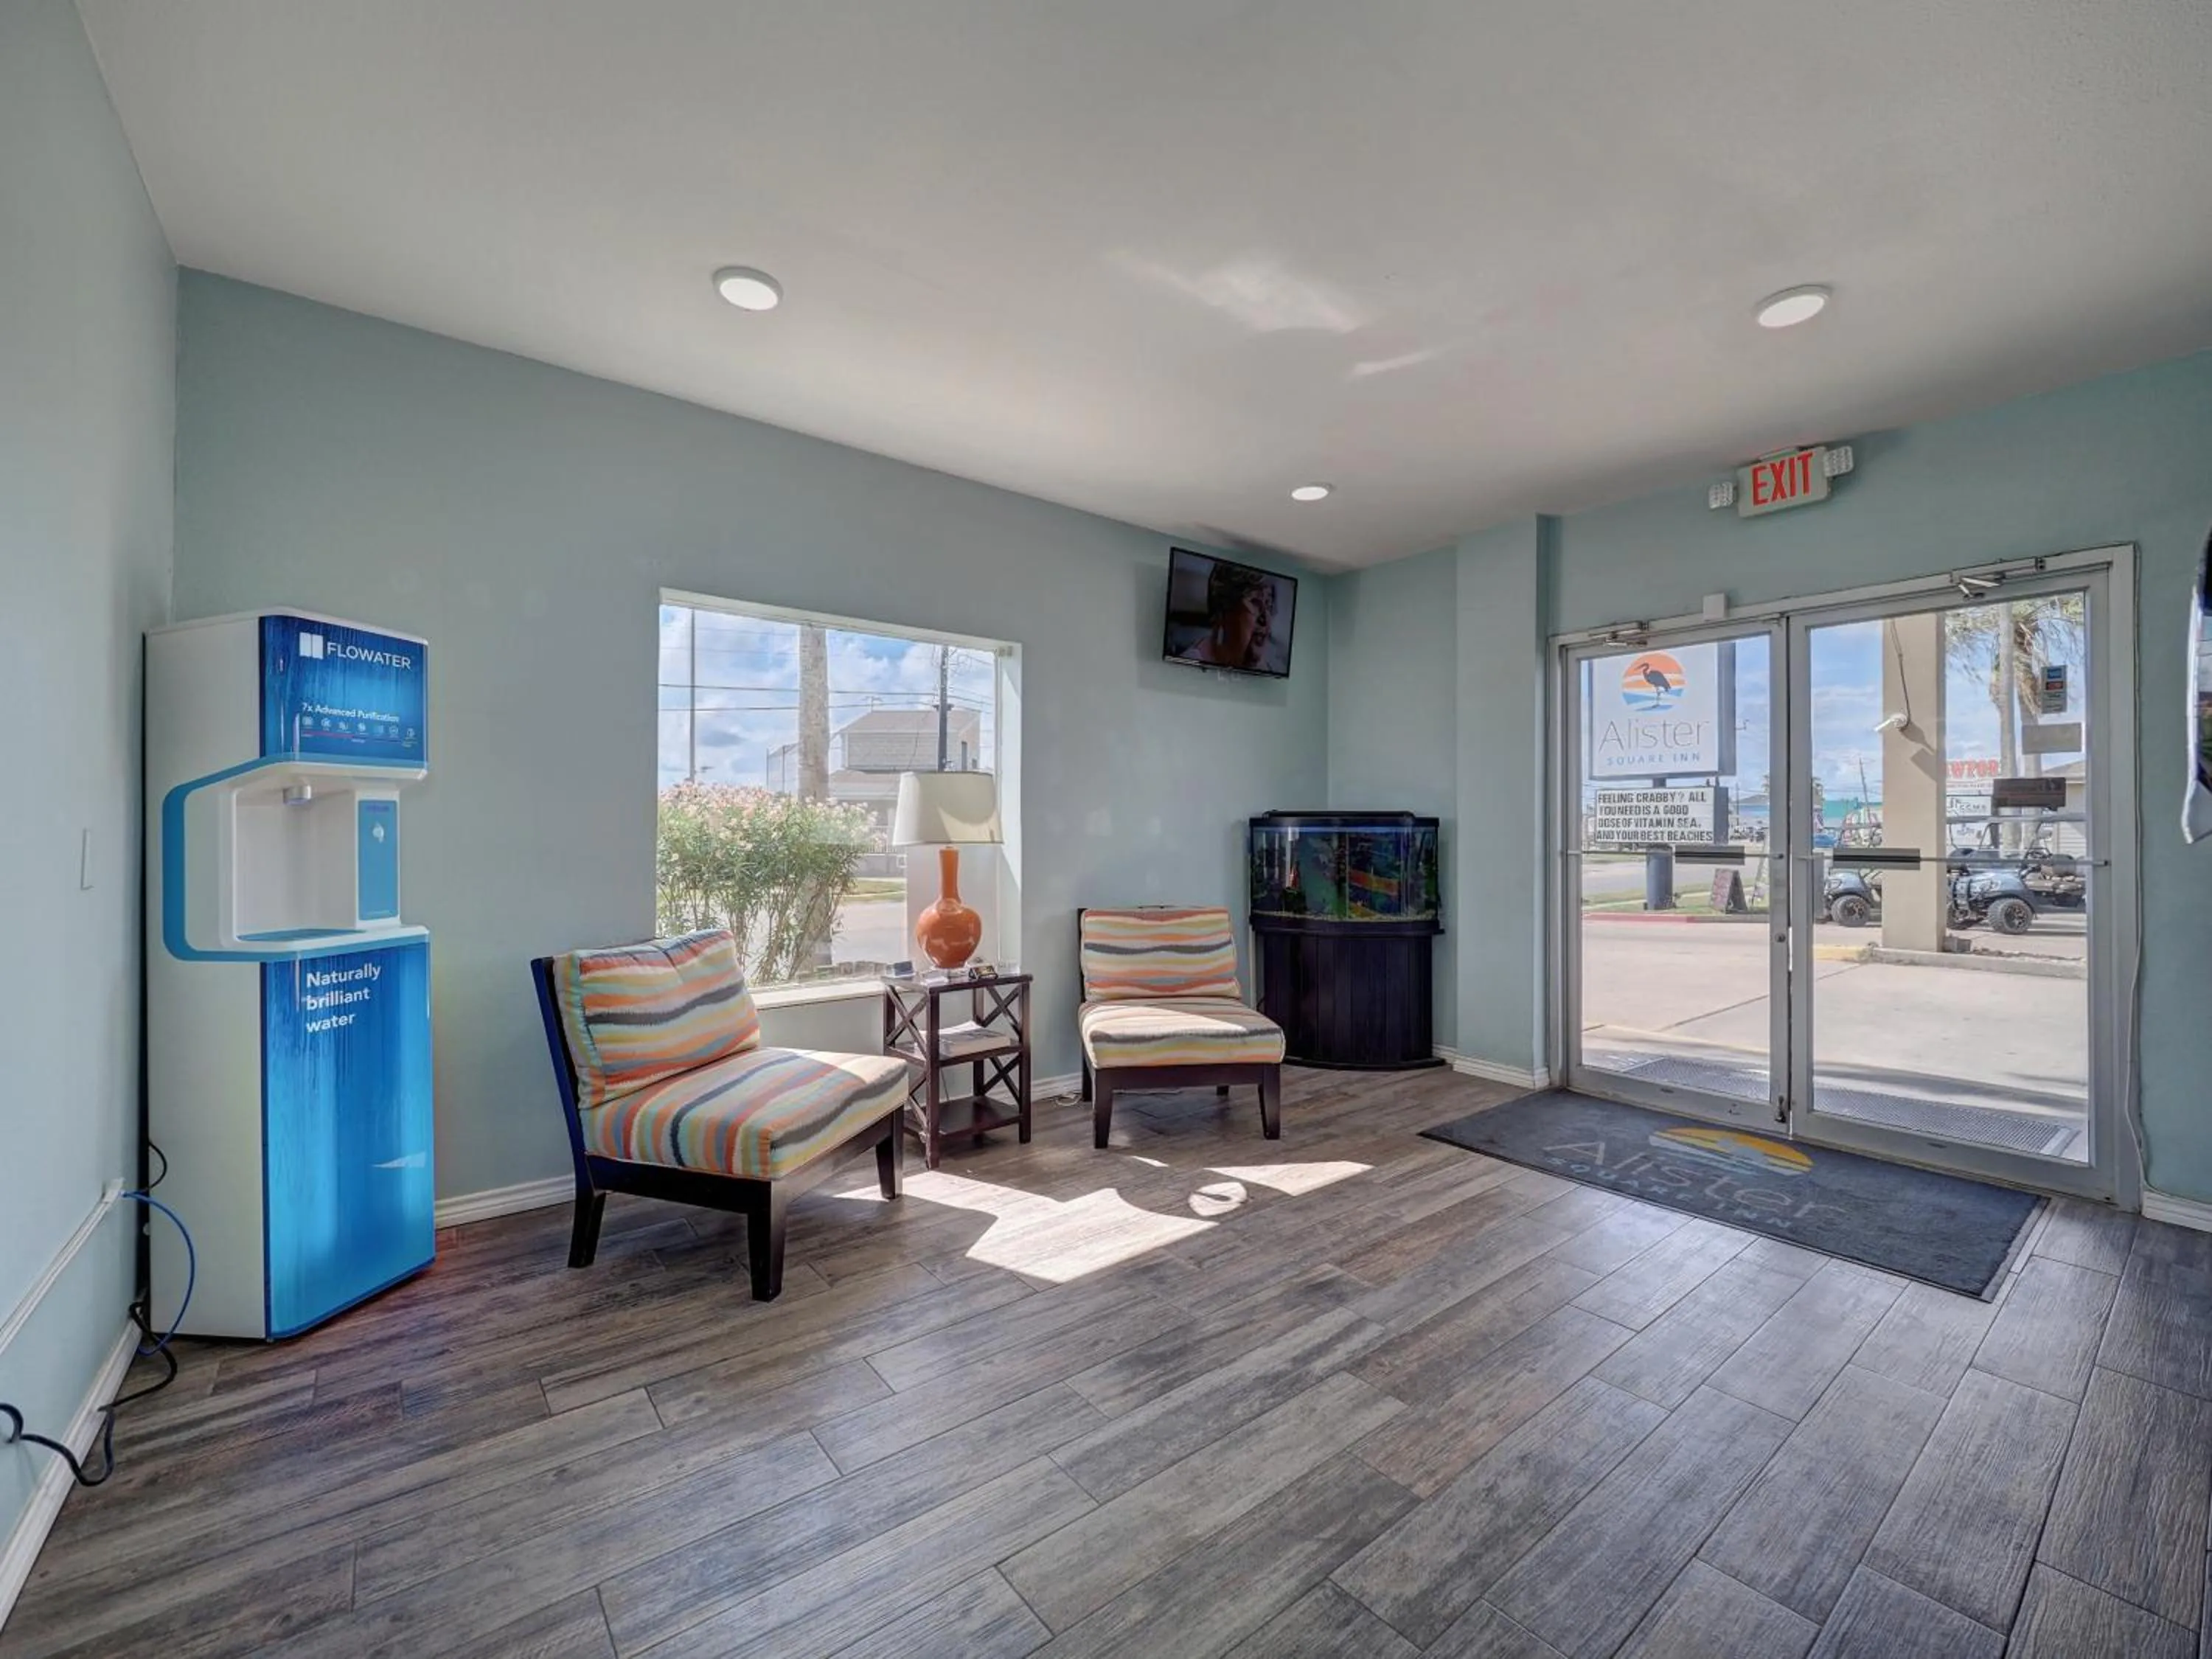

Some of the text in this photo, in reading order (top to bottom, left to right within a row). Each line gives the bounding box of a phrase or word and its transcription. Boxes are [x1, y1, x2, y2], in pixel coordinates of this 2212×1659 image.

[1752, 451, 1815, 506] EXIT
[327, 642, 411, 669] FLOWATER
[315, 705, 356, 717] Advanced
[358, 710, 400, 722] Purification
[1599, 717, 1710, 754] Alister
[1607, 752, 1700, 766] SQUARE INN
[1598, 792, 1634, 803] FEELING
[1688, 791, 1706, 802] ALL
[1653, 805, 1660, 815] A
[1663, 804, 1689, 815] GOOD
[1598, 818, 1622, 828] DOSE
[1622, 818, 1632, 827] OF
[1635, 818, 1674, 827] VITAMIN
[1596, 830, 1713, 841] AND YOUR BEST BEACHES
[306, 963, 381, 988] Naturally
[306, 987, 371, 1011] brilliant
[306, 1014, 355, 1033] water
[1544, 1141, 1845, 1218] Alister
[1545, 1155, 1694, 1201] SQUARE
